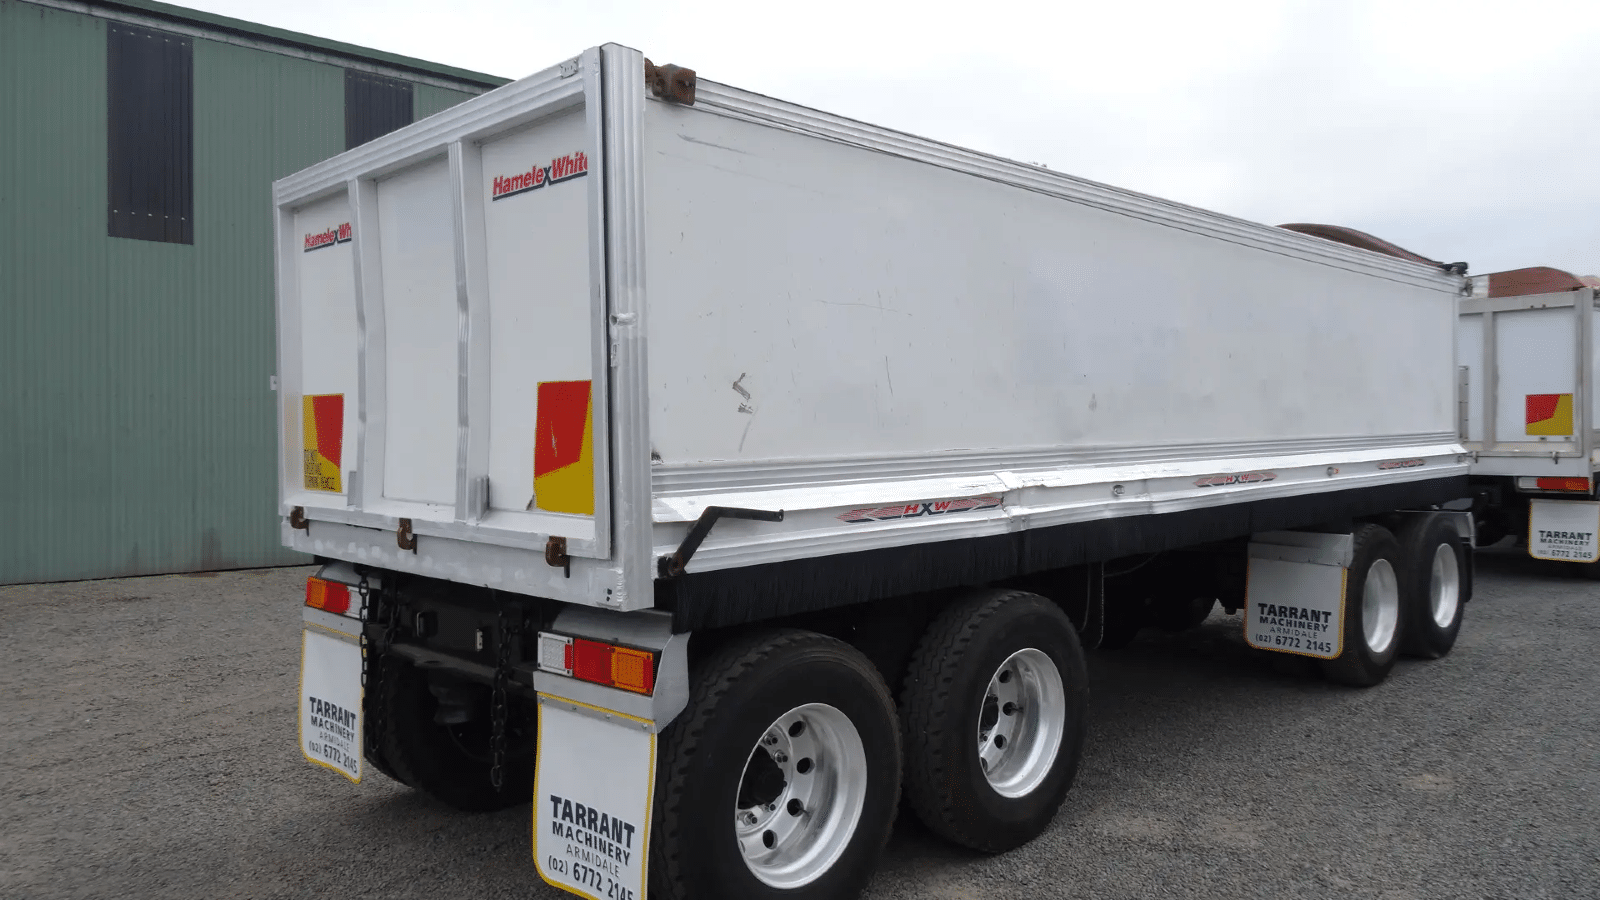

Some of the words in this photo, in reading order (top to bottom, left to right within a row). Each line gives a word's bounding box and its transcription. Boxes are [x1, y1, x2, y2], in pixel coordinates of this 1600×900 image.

[1538, 530, 1593, 541] TARRANT
[1540, 538, 1590, 546] MACHINERY
[1551, 549, 1570, 558] 6772
[1258, 603, 1332, 623] TARRANT
[1259, 616, 1328, 632] MACHINERY
[1255, 633, 1272, 643] (02)
[1275, 636, 1300, 648] 6772
[1306, 639, 1331, 653] 2145
[1270, 627, 1318, 639] ARMIDALE
[309, 696, 356, 731] TARRANT
[311, 715, 355, 743] MACHINERY
[319, 731, 350, 753] ARMIDALE
[323, 744, 342, 763] 6772
[343, 752, 357, 774] 2145
[550, 794, 635, 849] TARRANT
[552, 820, 631, 866] MACHINERY
[566, 843, 620, 878] ARMIDALE
[548, 855, 568, 875] (02)
[573, 862, 602, 892] 6772
